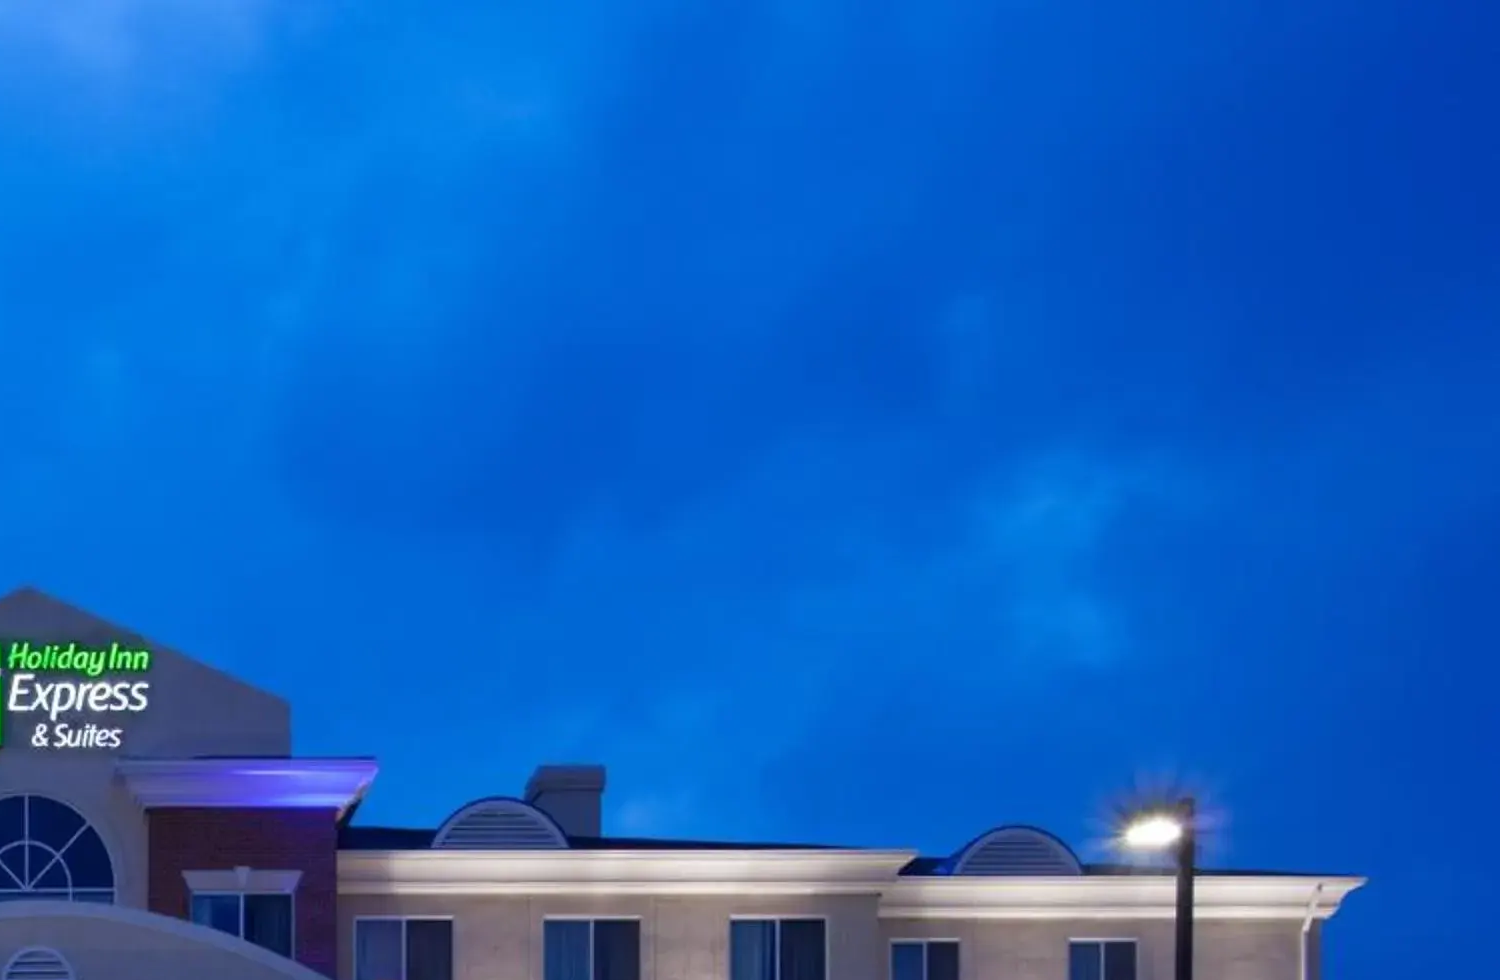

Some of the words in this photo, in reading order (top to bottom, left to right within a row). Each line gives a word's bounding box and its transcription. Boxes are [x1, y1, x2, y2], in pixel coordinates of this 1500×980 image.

[8, 642, 106, 676] Holiday
[109, 642, 150, 670] Inn
[7, 673, 150, 721] Express
[31, 723, 49, 747] &
[53, 723, 123, 747] Suites
